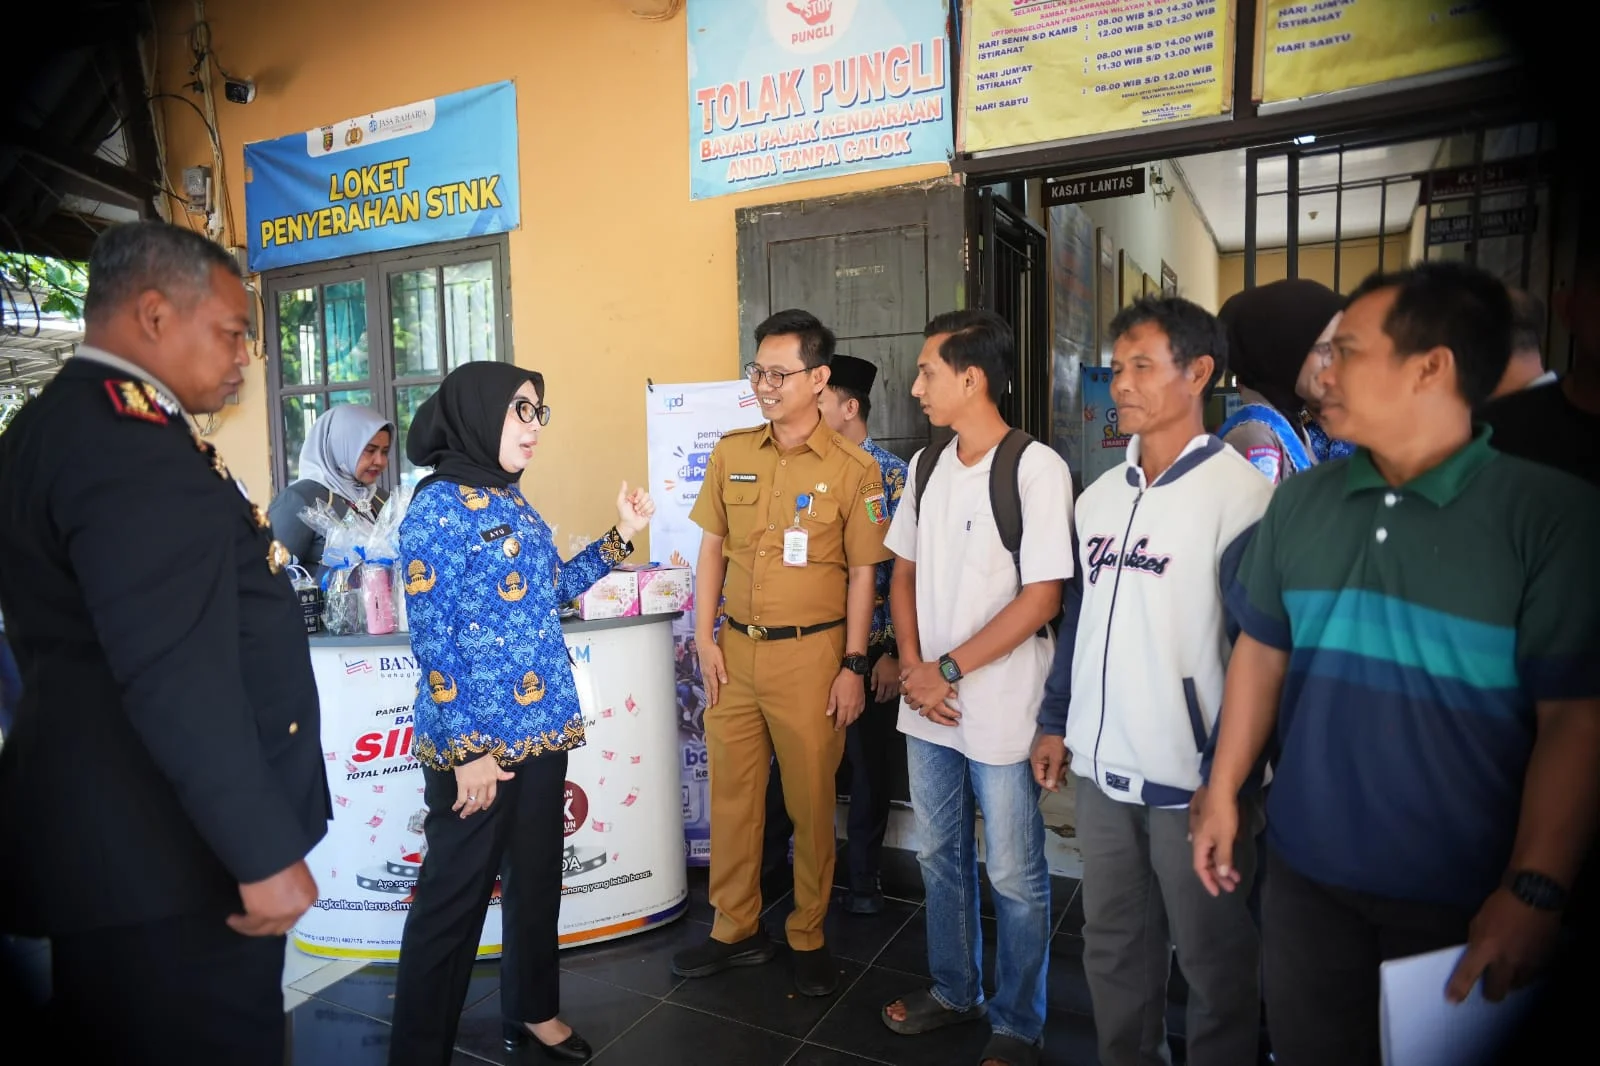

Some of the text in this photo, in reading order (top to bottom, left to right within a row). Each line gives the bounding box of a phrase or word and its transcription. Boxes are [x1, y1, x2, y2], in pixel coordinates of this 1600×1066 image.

[1013, 5, 1040, 16] SELAMA
[1040, 9, 1068, 19] SAMSAT
[1097, 16, 1123, 26] 08.00
[1125, 12, 1145, 22] WIB
[1147, 8, 1163, 17] S/D
[1166, 2, 1193, 13] 14.30
[1278, 6, 1307, 17] HARI
[1097, 7, 1215, 38] 12.00 WIB S/D 12.30 WIB
[1278, 11, 1342, 29] ISTIRAHAT
[791, 24, 833, 45] PUNGLI
[978, 25, 1078, 50] HARI SENIN S/D KAMIS
[1096, 30, 1214, 60] 08.00 WIB S/D 14.00 WIB
[1277, 33, 1351, 53] HARI SABTU
[978, 46, 1025, 61] ISTIRAHAT
[1096, 42, 1213, 71] 11.30 WIB S/D 13.00 WIB
[977, 65, 1032, 80] HARI JUM'AT
[1095, 65, 1212, 93] 08.00 WIB S/D 12.00 WIB
[697, 38, 945, 135] TOLAK PUNGLI
[977, 77, 1022, 91] ISTIRAHAT
[975, 97, 1028, 111] HARI SABTU
[701, 95, 944, 163] BAYAR PAJAK KENDARAAN
[727, 151, 777, 182] ANDA
[780, 144, 840, 174] TANPA
[329, 157, 410, 201] LOKET
[1051, 176, 1133, 198] KASAT LANTAS
[261, 175, 502, 248] PENYERAHAN STNK
[697, 429, 723, 440] pemb
[694, 441, 715, 449] kend
[489, 528, 505, 538] AYU
[376, 705, 409, 716] PANEN
[395, 714, 414, 725] BA
[347, 770, 379, 781] TOTAL
[696, 769, 708, 778] ke
[377, 879, 417, 889] Ayo seger
[589, 881, 609, 893] yang
[609, 875, 630, 887] lebih
[630, 870, 652, 881] besar.
[364, 899, 388, 911] terus
[390, 901, 413, 911] sim
